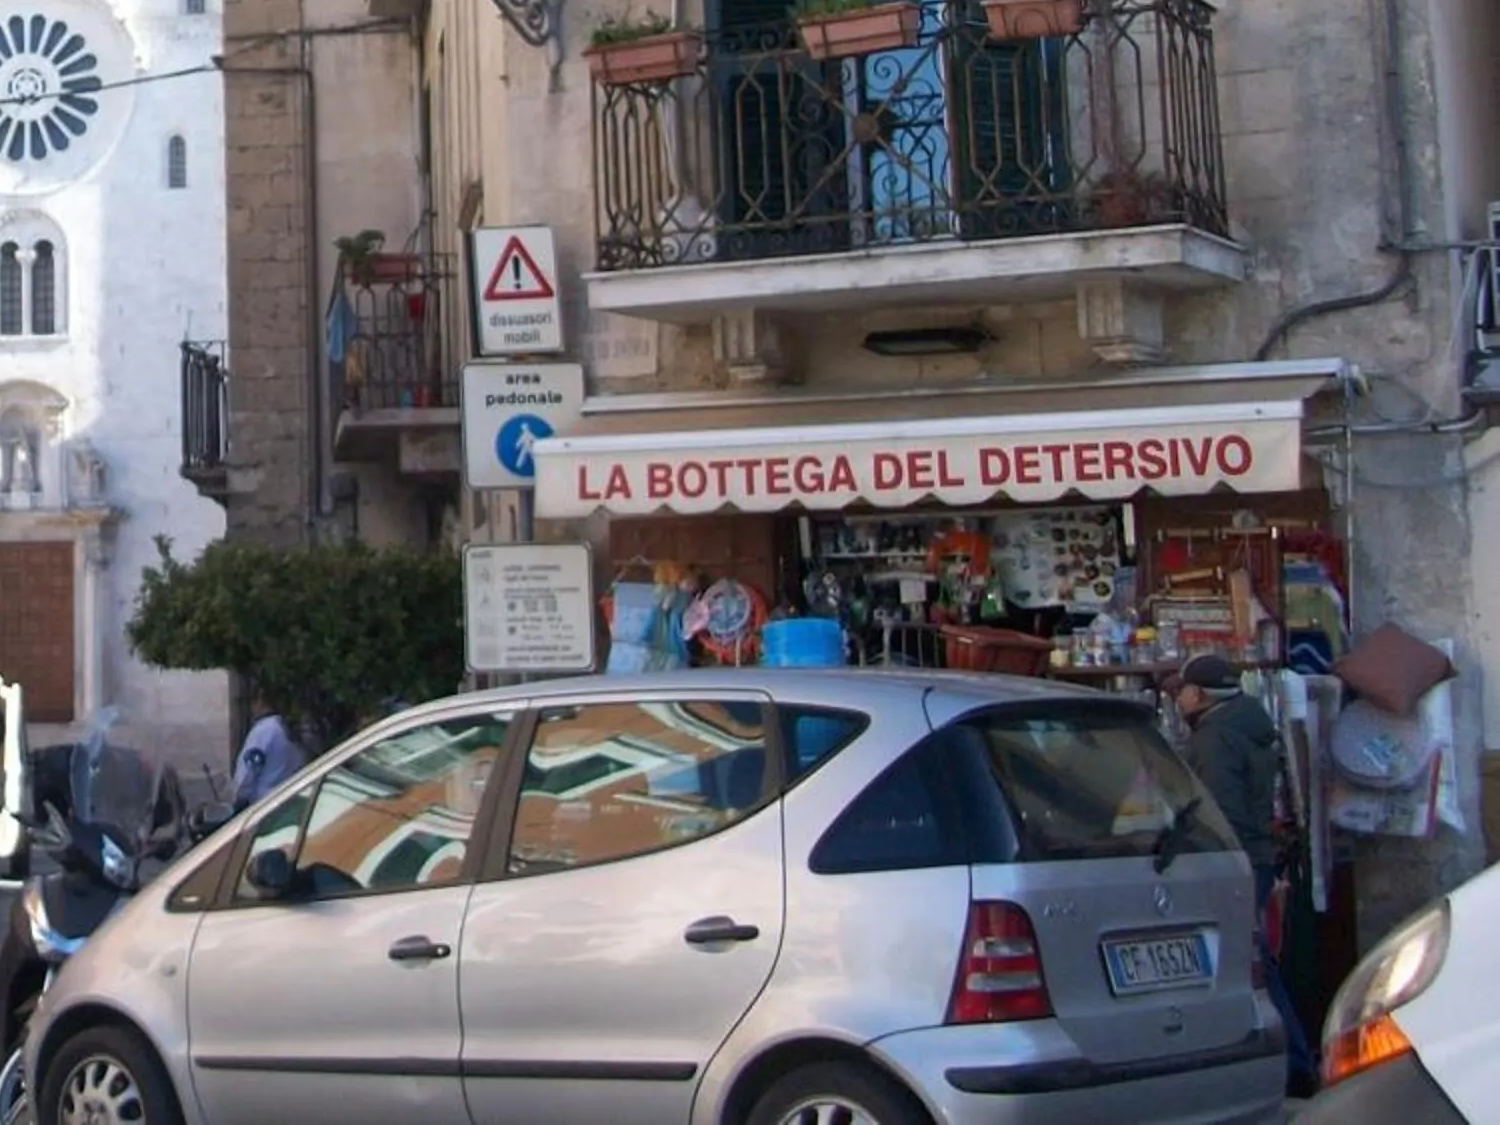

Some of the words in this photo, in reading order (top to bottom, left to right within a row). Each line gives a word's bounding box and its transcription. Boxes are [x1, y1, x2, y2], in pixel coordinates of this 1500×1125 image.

[503, 329, 541, 344] mobili
[505, 373, 541, 385] area
[485, 390, 563, 407] pedonale
[578, 463, 632, 500] LA
[647, 453, 858, 499] BOTTEGA
[873, 448, 965, 490] DEL
[979, 434, 1253, 486] DETERSIVO
